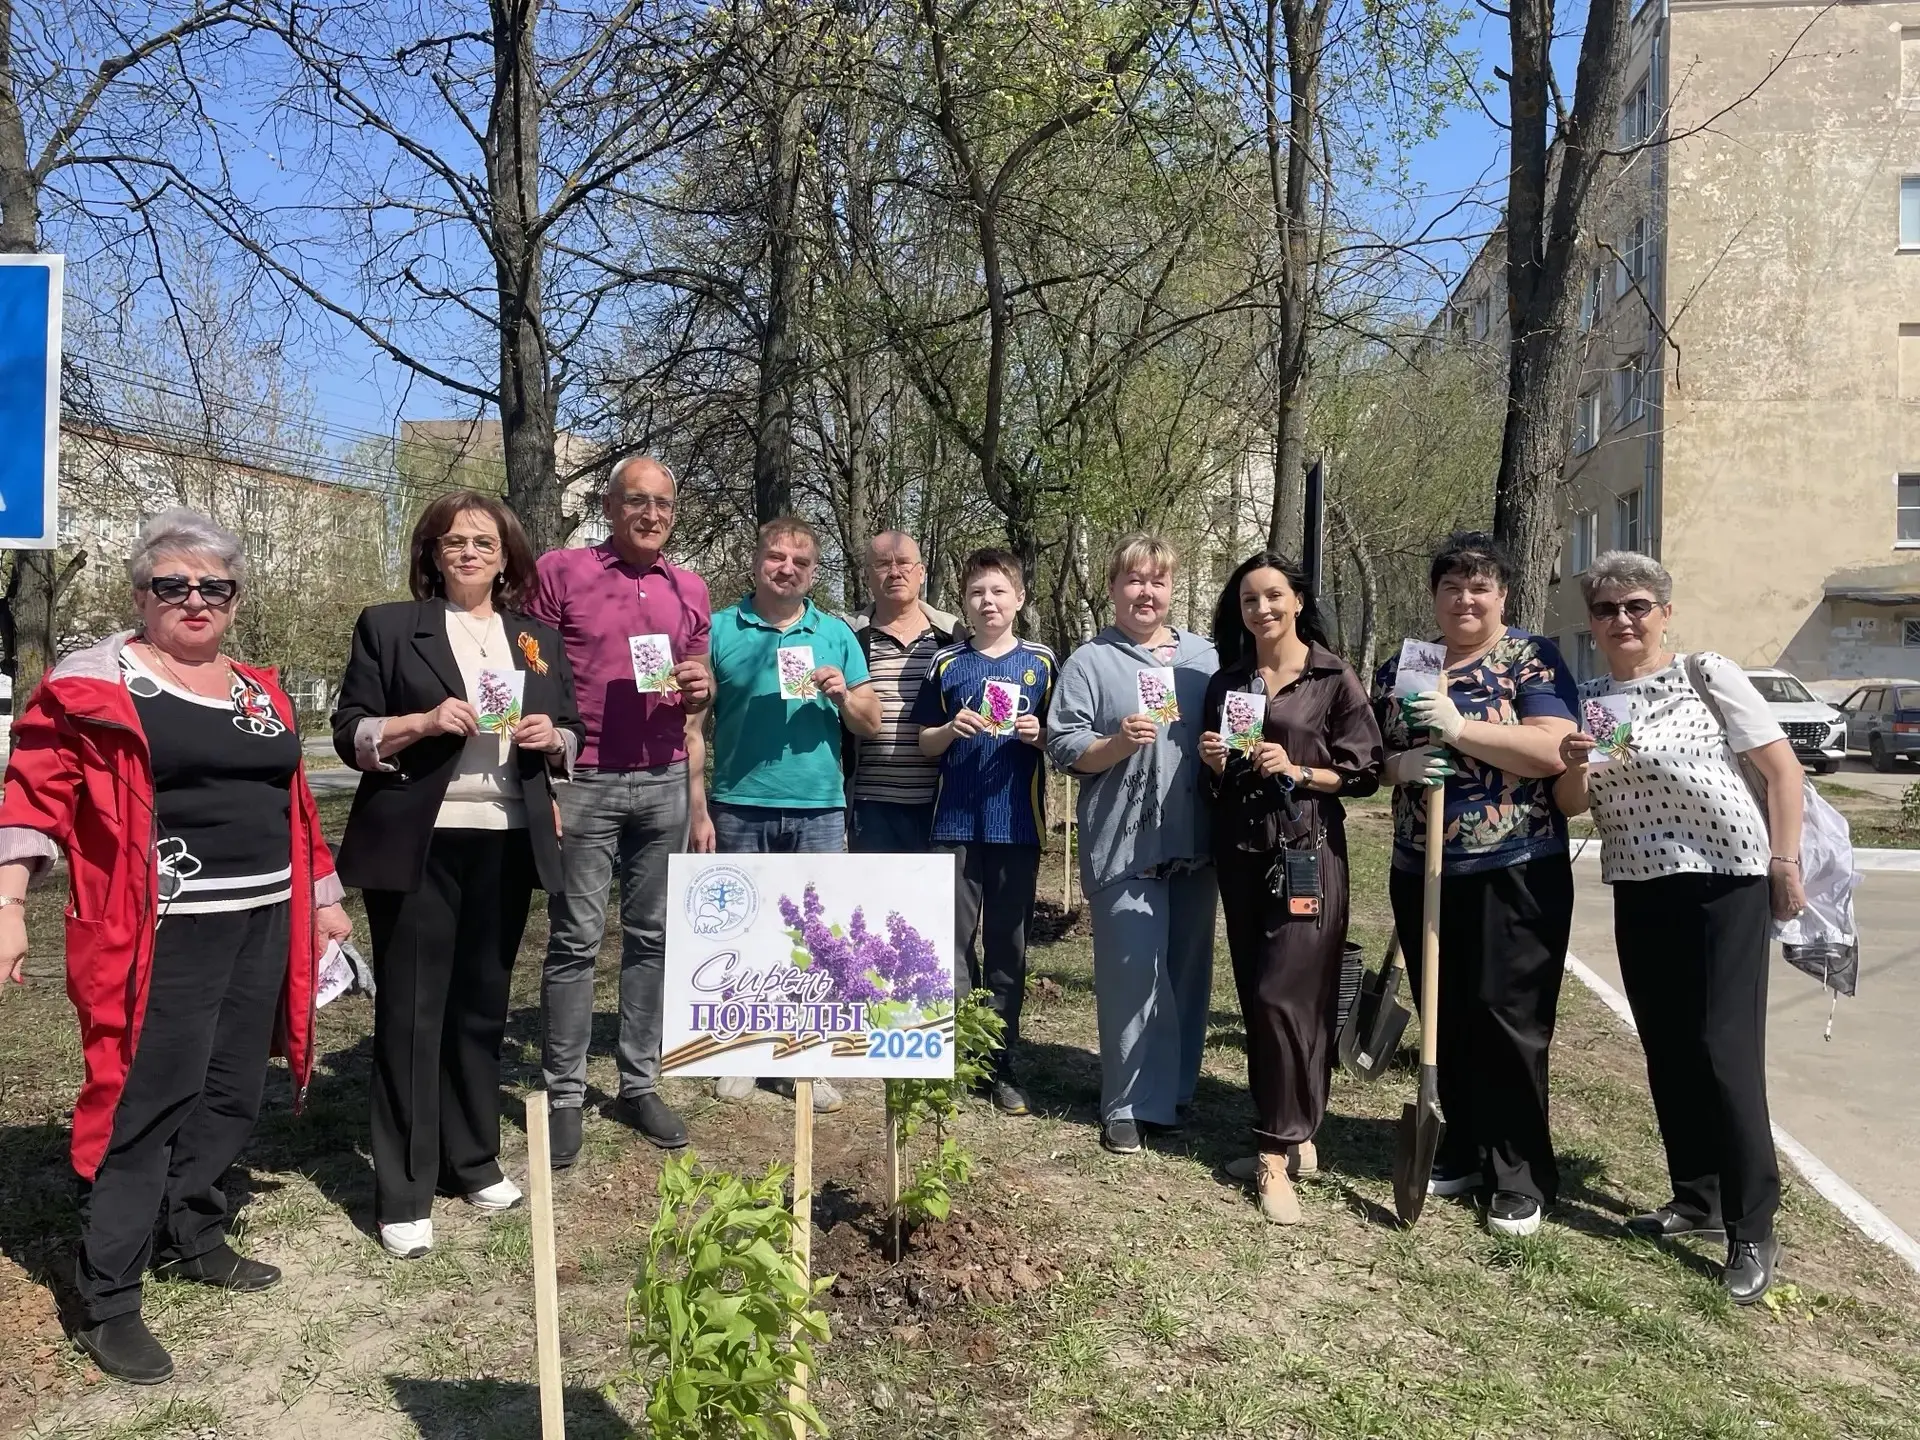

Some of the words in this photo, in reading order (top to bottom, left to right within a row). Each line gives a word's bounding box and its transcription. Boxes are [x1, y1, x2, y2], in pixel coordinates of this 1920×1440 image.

[692, 951, 833, 1003] Сирень
[689, 1002, 866, 1040] ПОБЕДЫ
[869, 1032, 942, 1058] 2026
